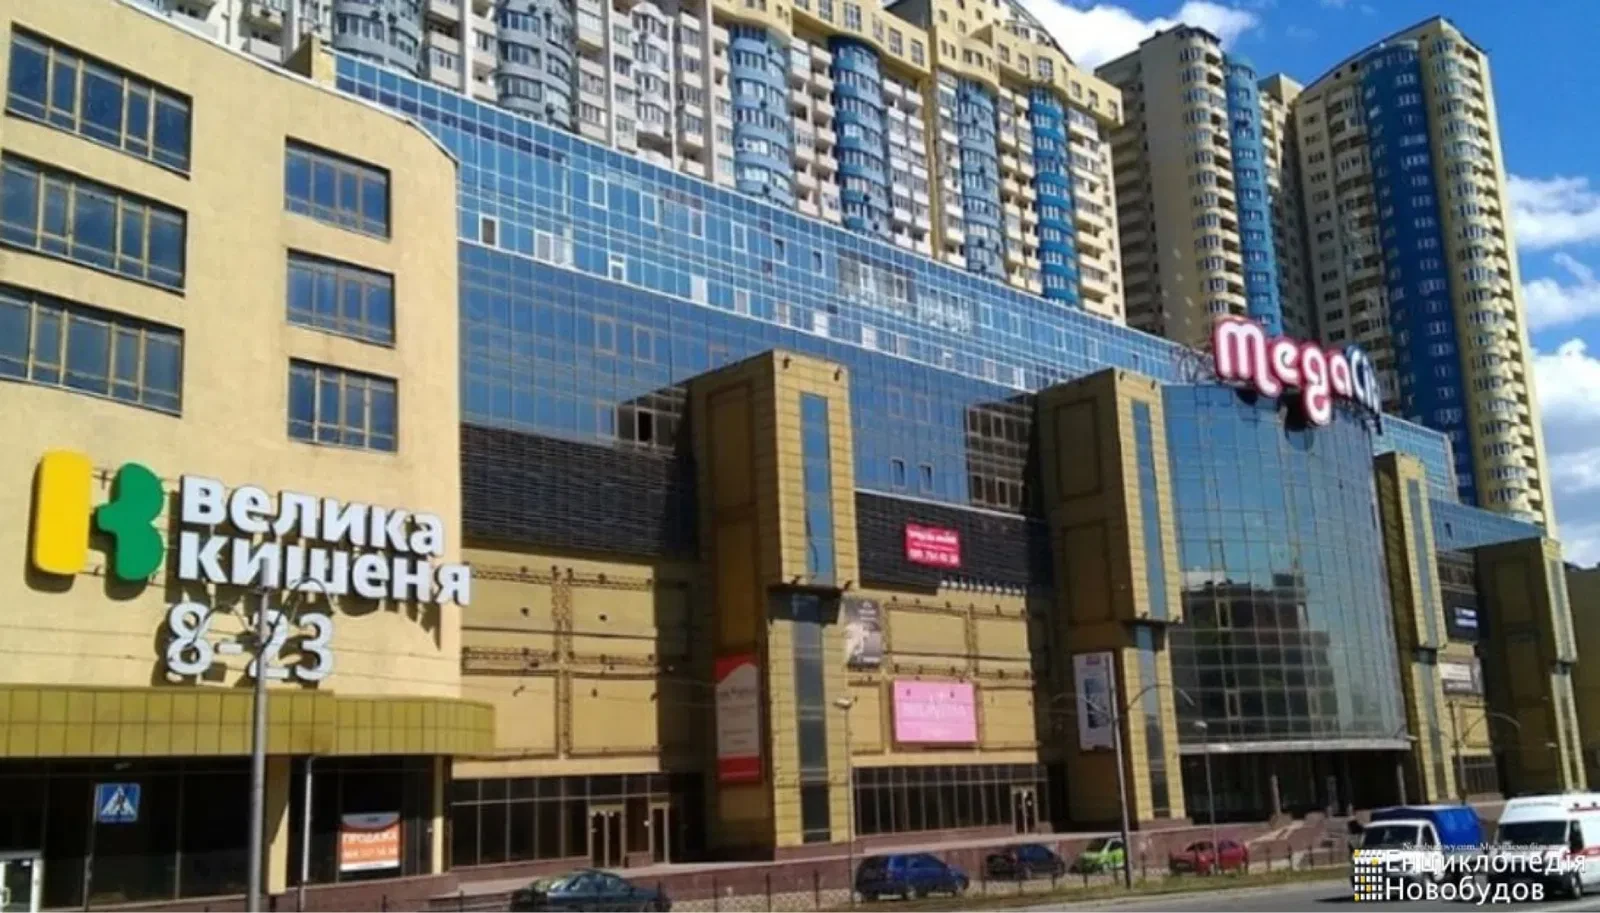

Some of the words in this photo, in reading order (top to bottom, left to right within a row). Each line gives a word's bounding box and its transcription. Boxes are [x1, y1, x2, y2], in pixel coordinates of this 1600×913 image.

[181, 475, 445, 557] велика
[178, 532, 471, 606] кишеня
[166, 602, 335, 681] 8-23
